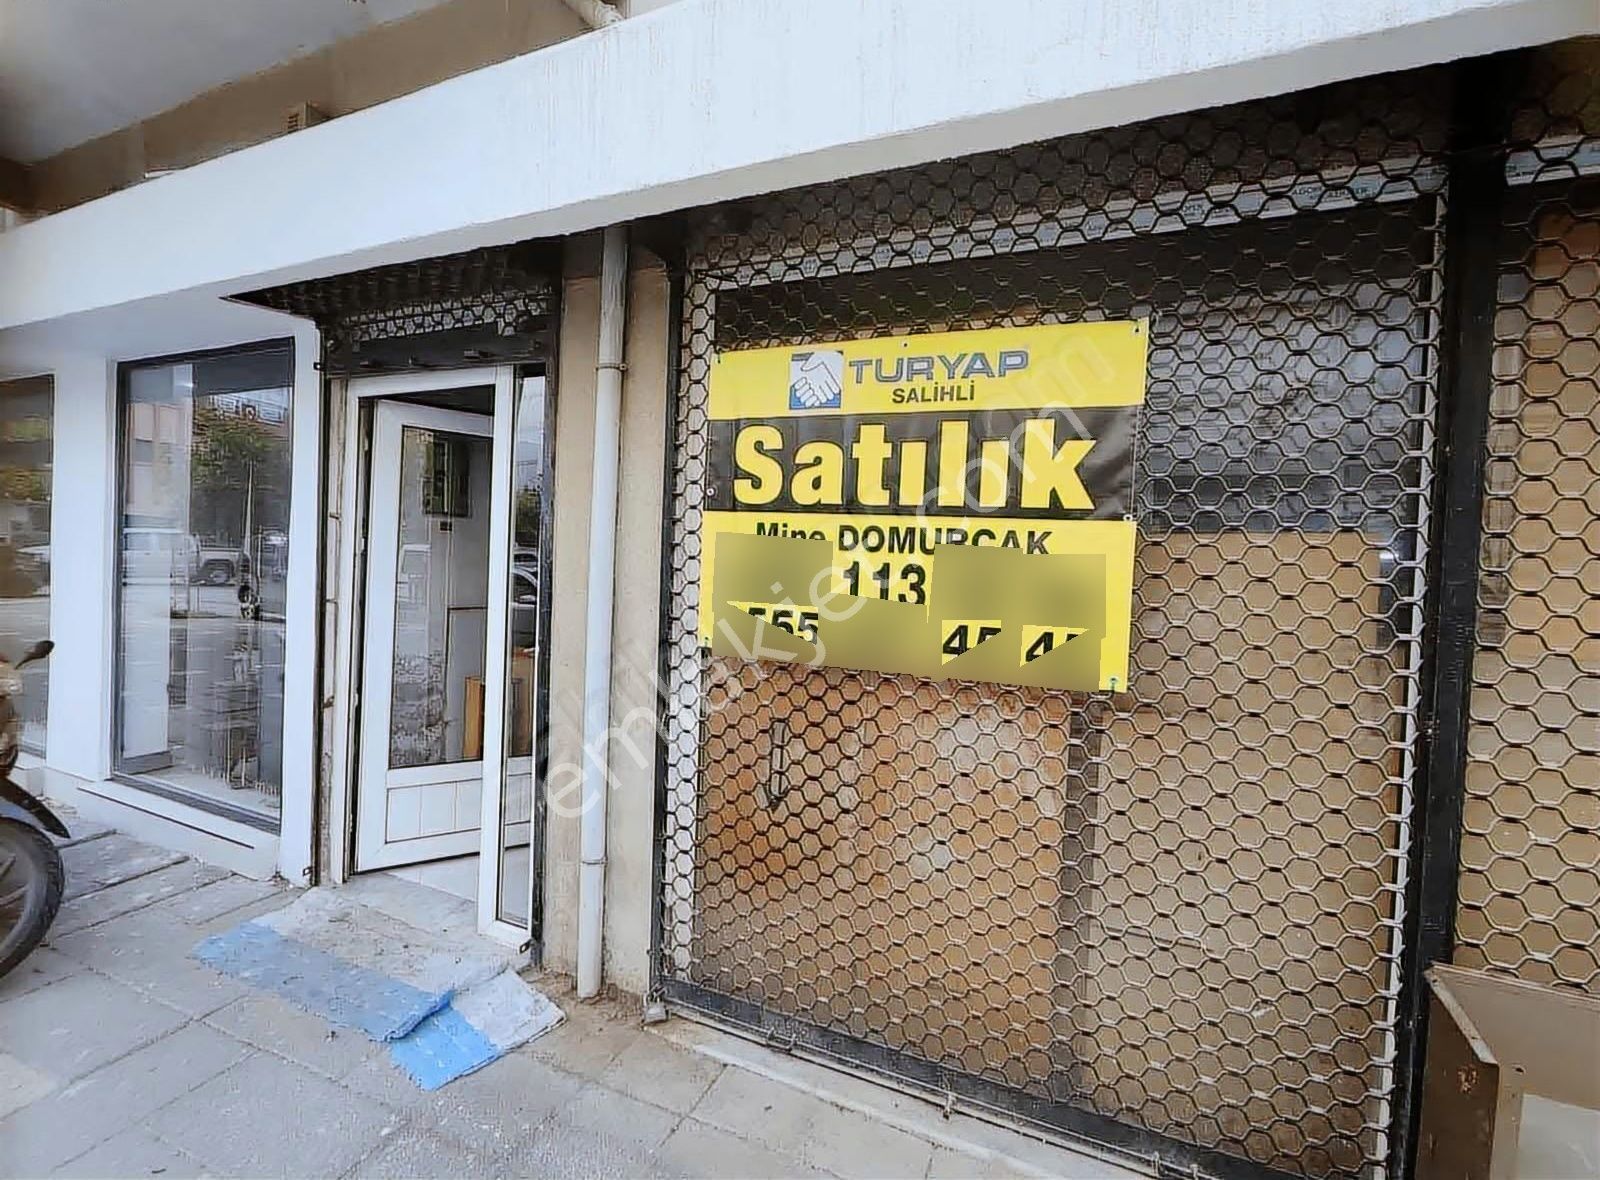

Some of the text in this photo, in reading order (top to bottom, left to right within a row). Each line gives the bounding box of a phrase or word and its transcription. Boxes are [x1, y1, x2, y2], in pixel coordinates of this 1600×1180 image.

[848, 349, 1030, 384] TURYAP
[892, 380, 976, 405] SALİHLİ
[733, 417, 1097, 511] Satılık
